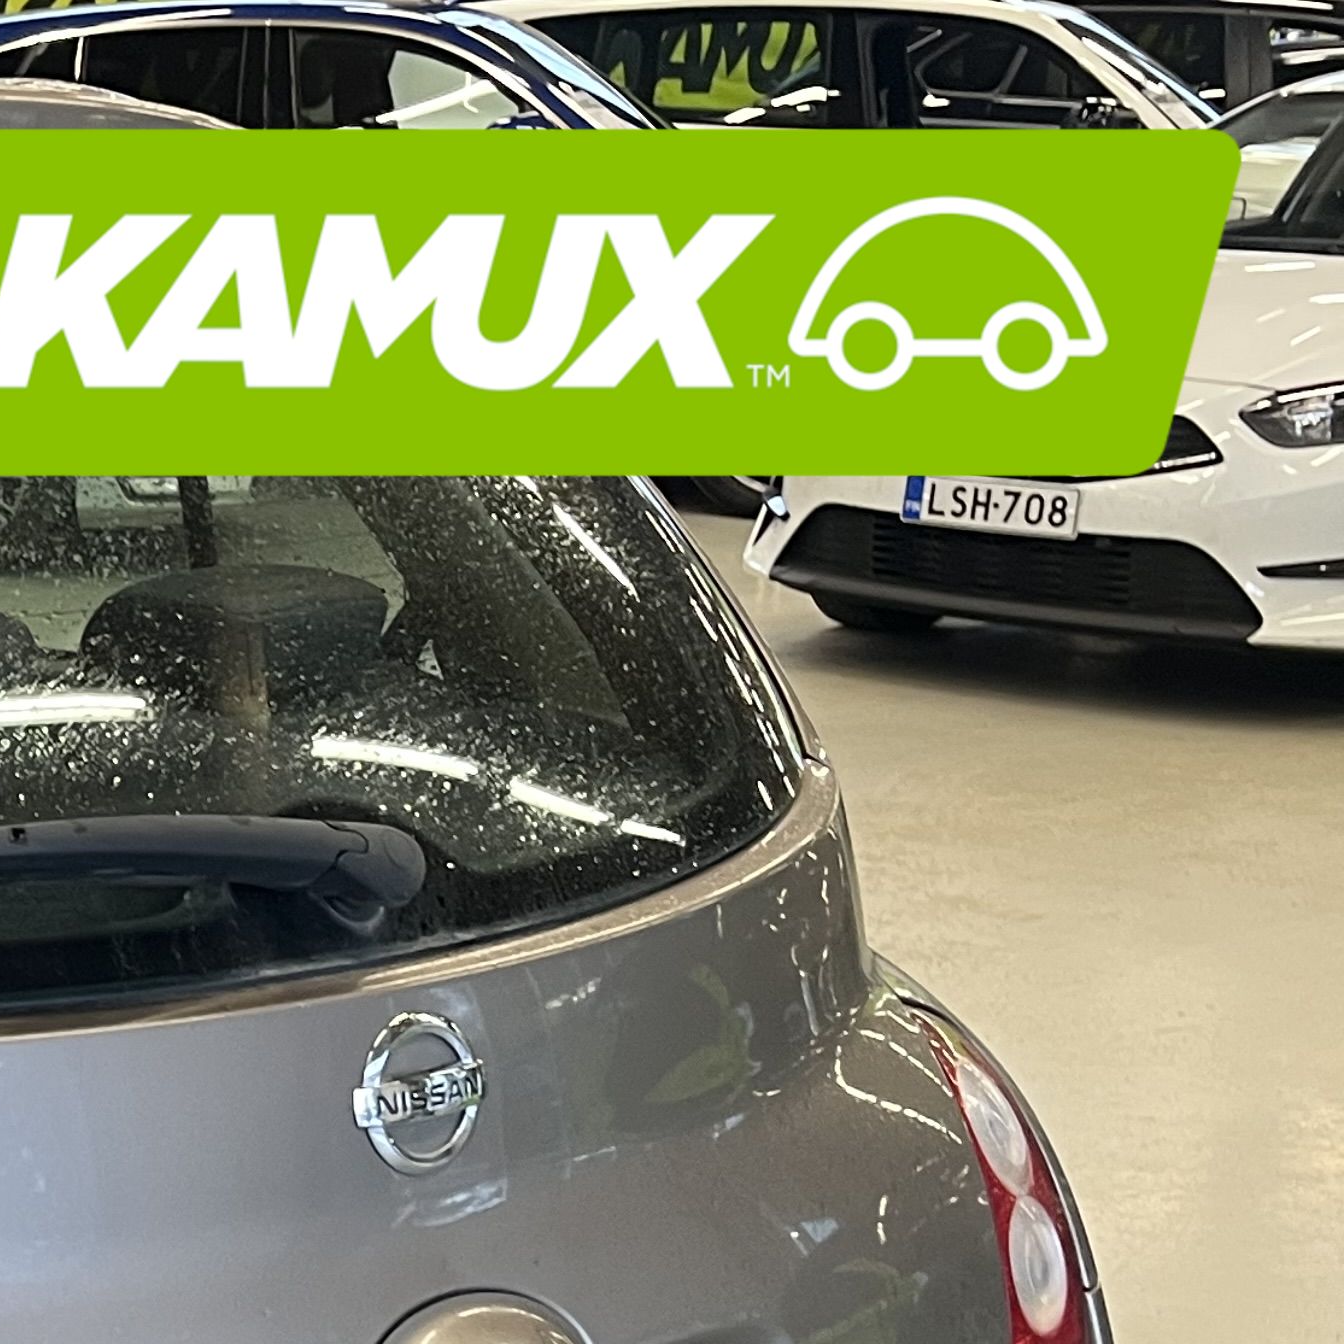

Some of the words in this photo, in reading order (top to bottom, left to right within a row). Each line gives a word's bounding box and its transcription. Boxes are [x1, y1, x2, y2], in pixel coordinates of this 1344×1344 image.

[609, 19, 820, 94] AMU
[926, 482, 1068, 528] LSH-708
[377, 1068, 482, 1116] NISSAN
